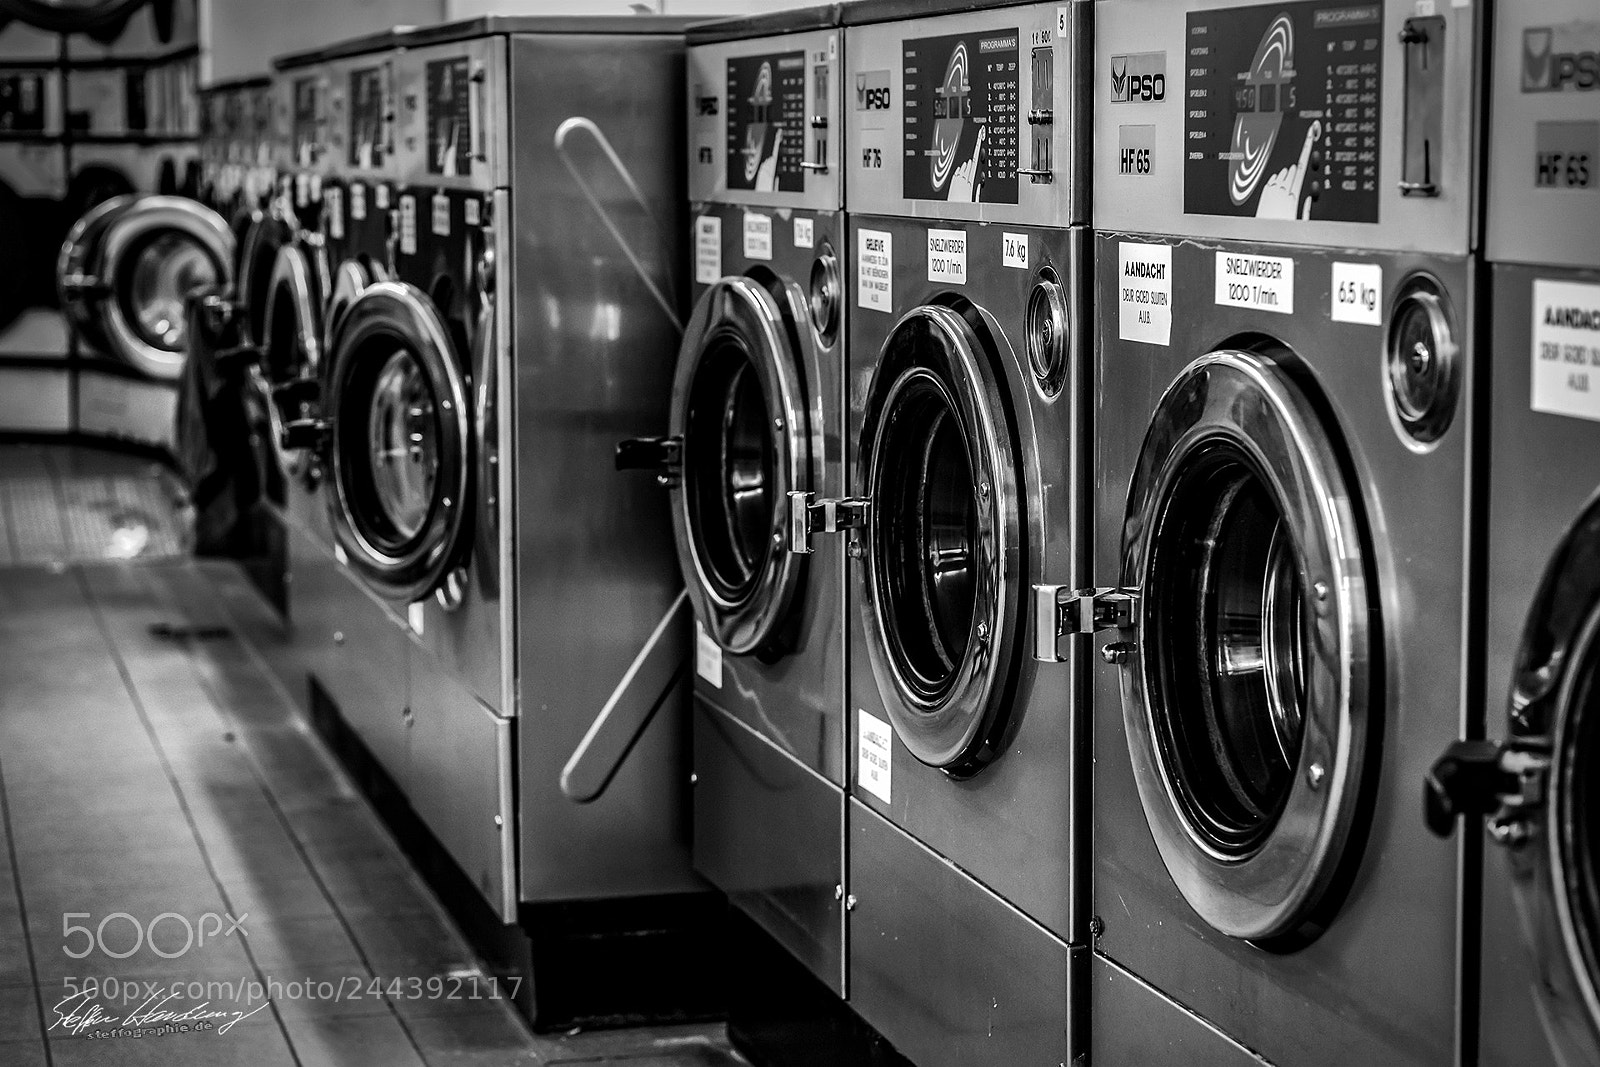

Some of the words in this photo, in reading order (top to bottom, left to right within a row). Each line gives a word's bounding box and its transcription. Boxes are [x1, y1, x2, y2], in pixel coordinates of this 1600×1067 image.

[1059, 14, 1065, 31] 5
[981, 38, 1017, 50] PROGRAMMA'S
[1551, 52, 1600, 91] IPS
[1127, 74, 1165, 102] IPSO
[1121, 148, 1136, 173] HF
[1137, 148, 1150, 174] 65
[1537, 152, 1563, 187] HF
[1006, 239, 1015, 257] 7.6
[1017, 240, 1026, 262] kg
[1124, 260, 1166, 280] AANDACHT
[1226, 257, 1283, 279] SNELZWIERDER
[1122, 288, 1134, 302] DEUR
[1135, 289, 1150, 304] GOED
[1150, 291, 1168, 306] SLUITEN
[1228, 283, 1250, 302] 1200
[1338, 281, 1356, 304] 6.5
[1361, 282, 1376, 312] kg
